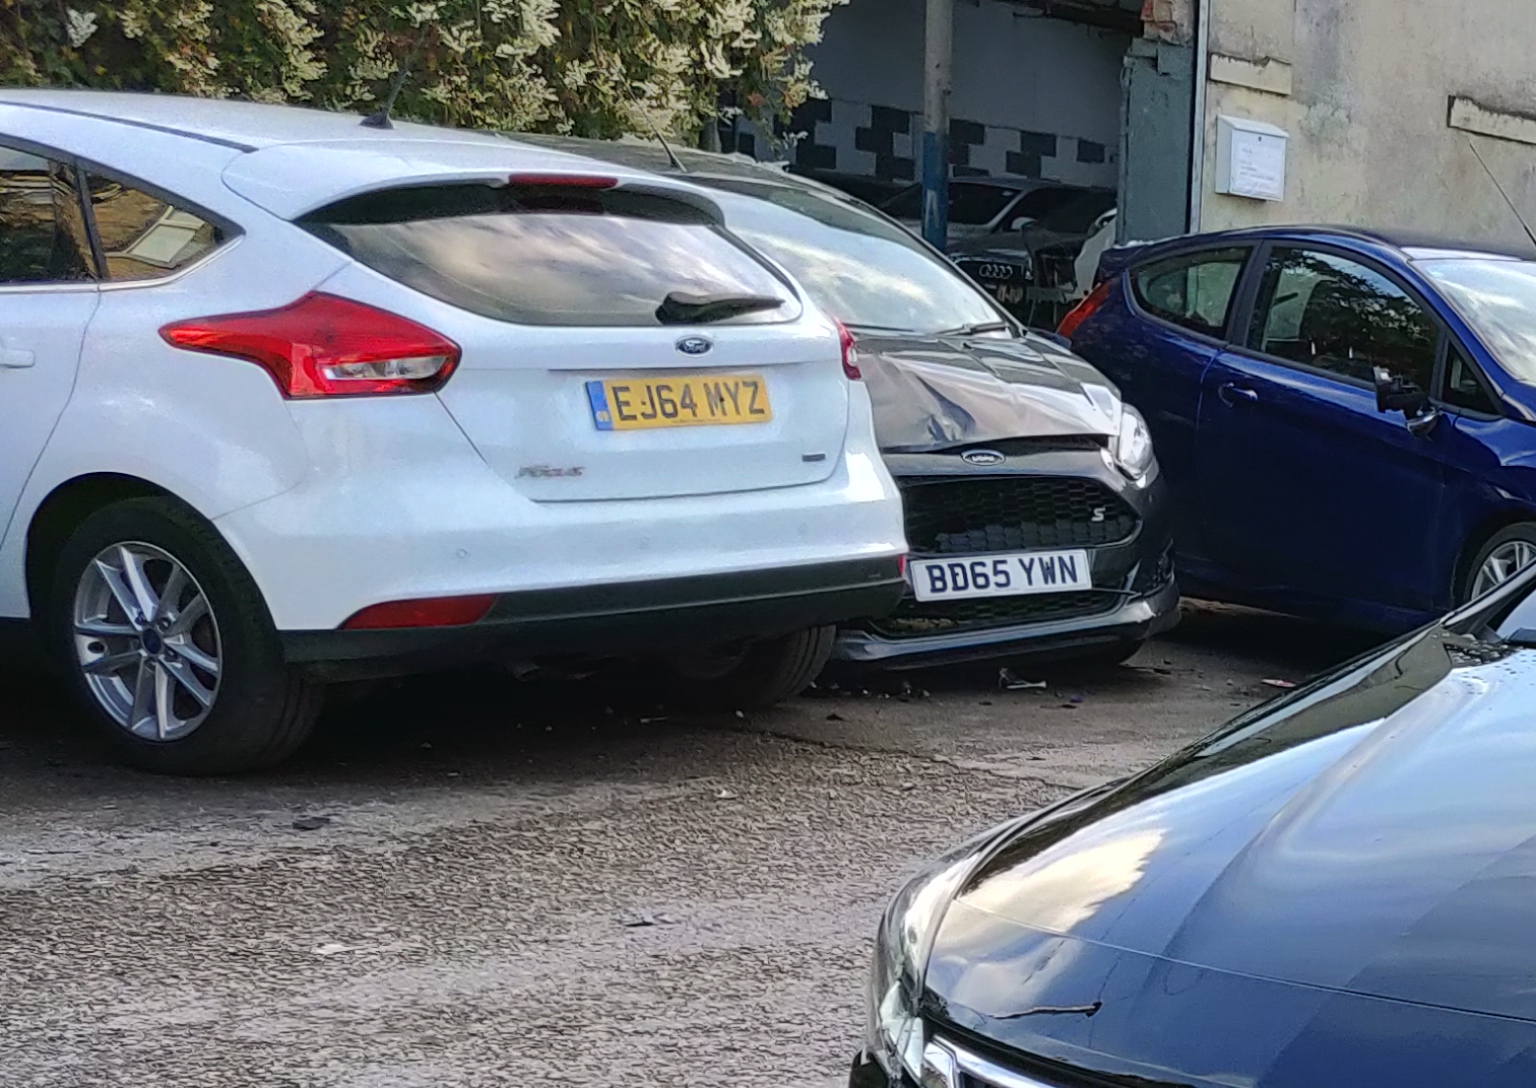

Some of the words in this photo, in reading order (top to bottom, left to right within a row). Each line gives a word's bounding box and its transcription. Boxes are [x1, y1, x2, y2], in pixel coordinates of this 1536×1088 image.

[611, 383, 698, 422] EJ64
[703, 380, 766, 417] MYZ
[925, 559, 1011, 594] BD65
[1017, 555, 1078, 587] YWN
